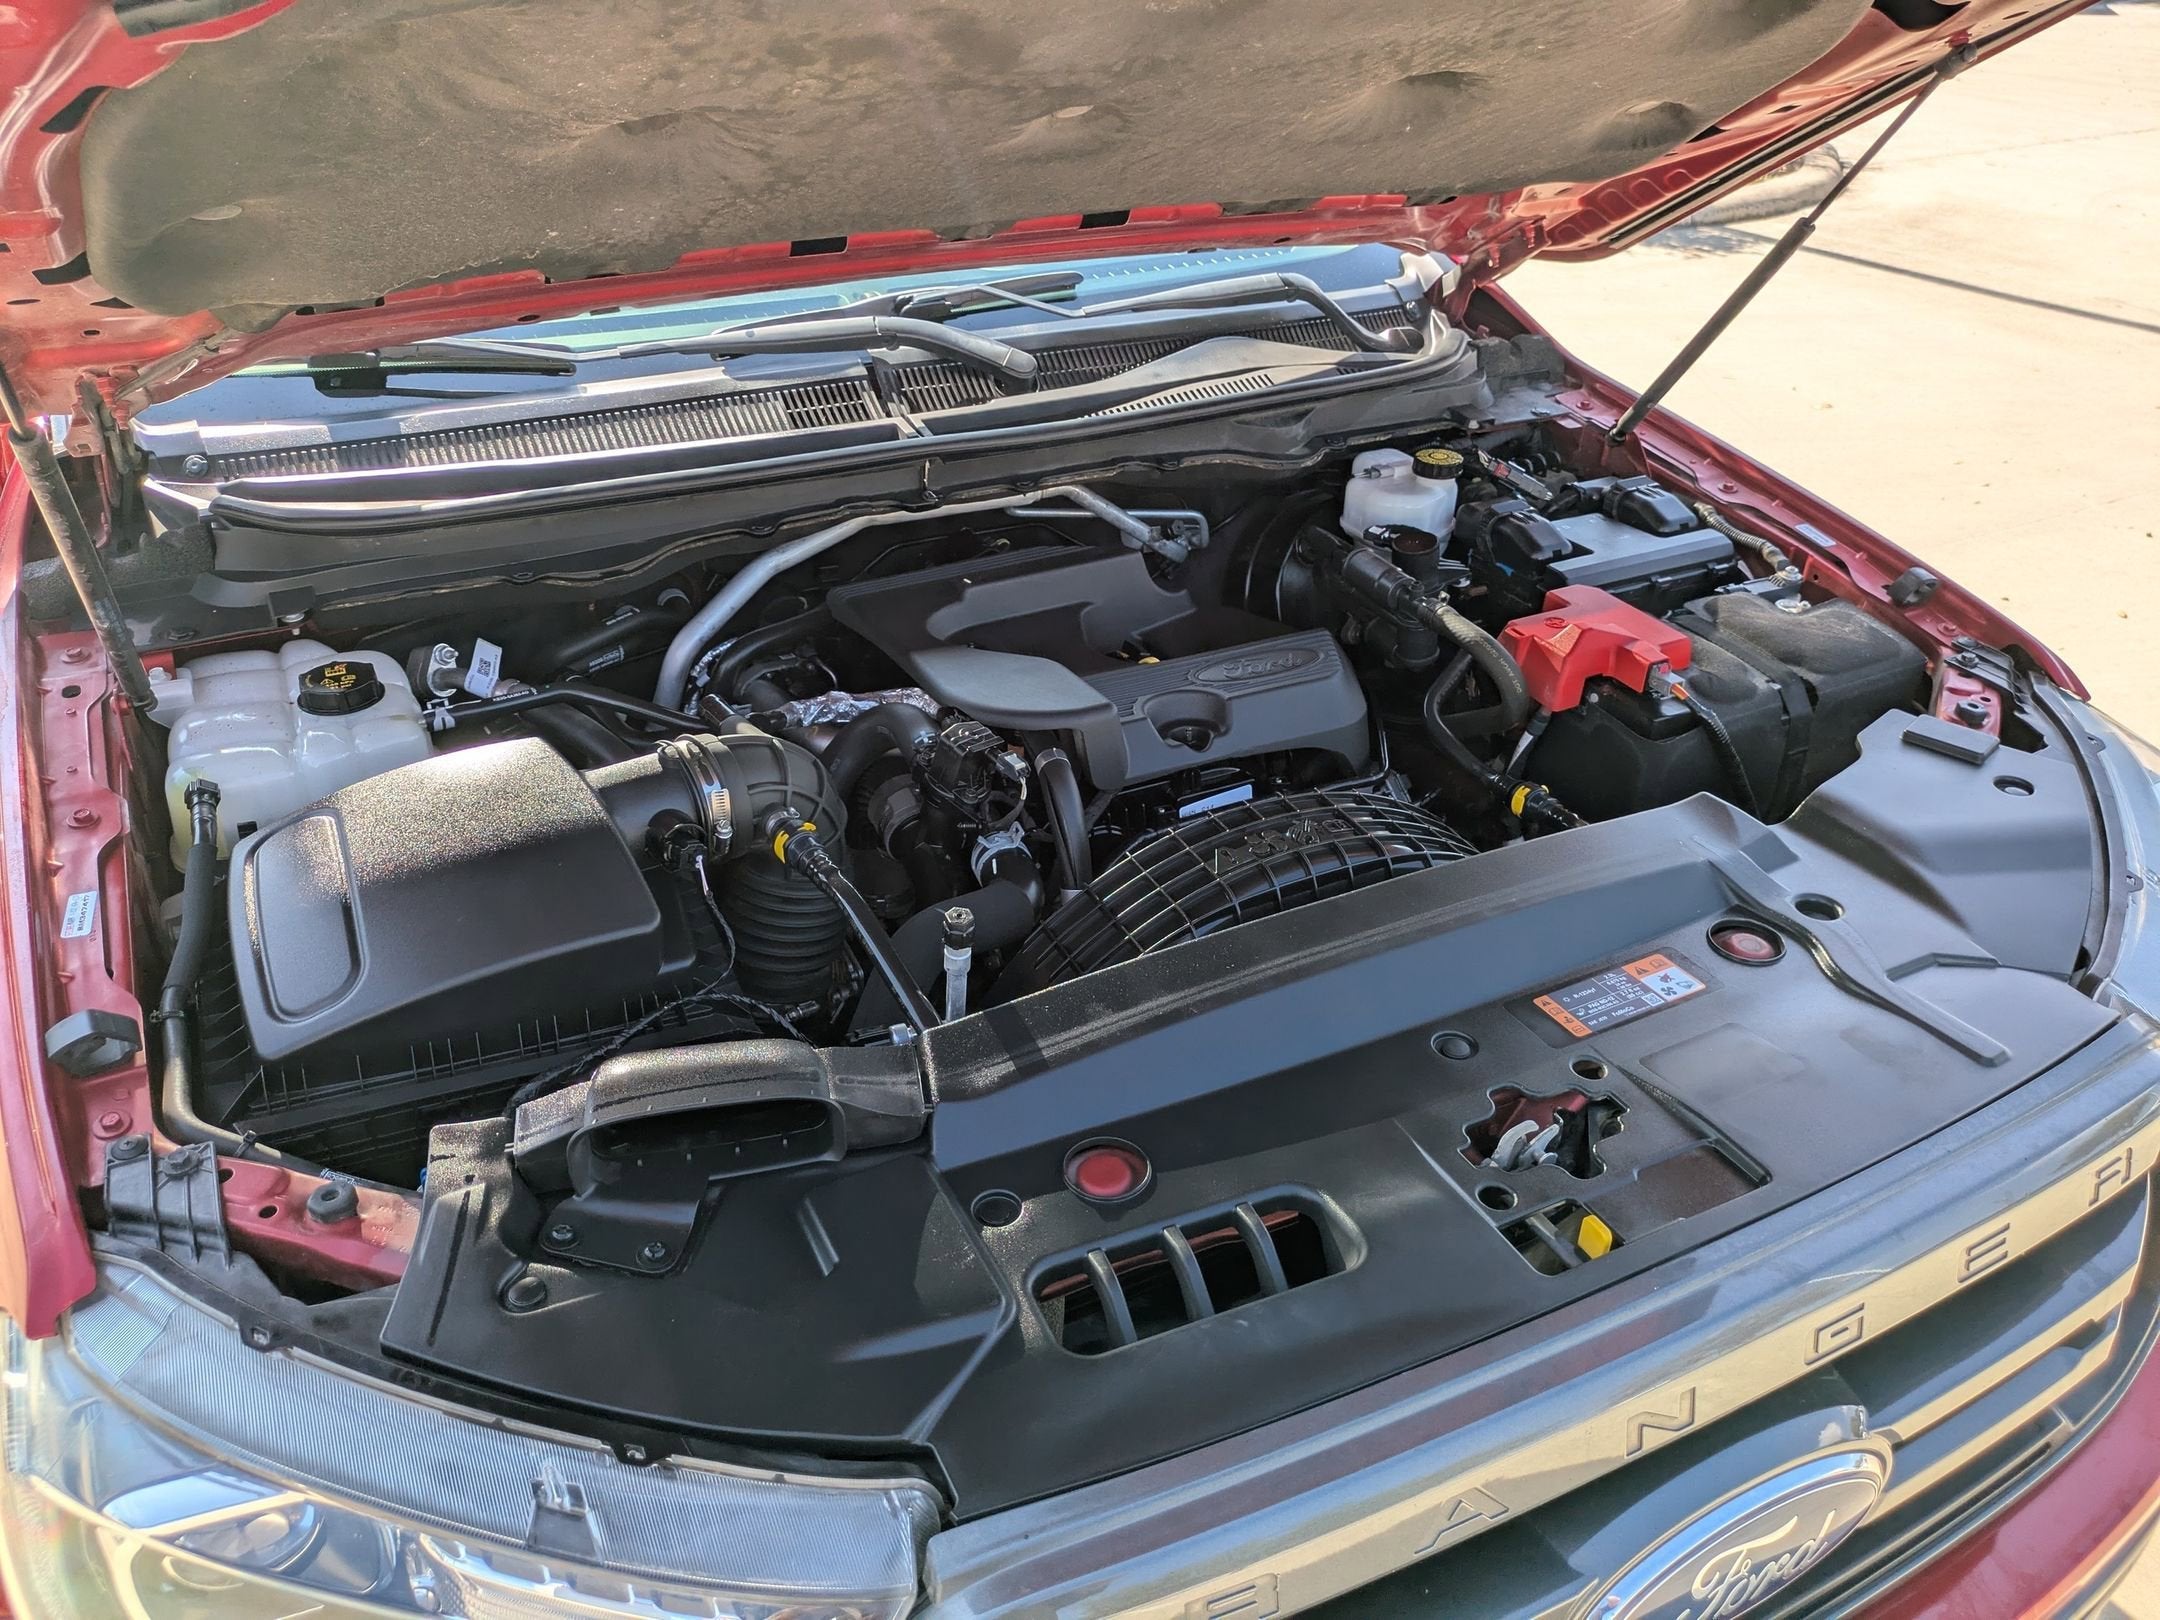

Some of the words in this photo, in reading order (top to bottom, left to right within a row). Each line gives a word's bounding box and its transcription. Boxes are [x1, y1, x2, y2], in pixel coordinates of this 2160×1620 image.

[1222, 652, 1303, 679] Ford
[1184, 1147, 2133, 1620] RANGER
[1676, 1508, 1837, 1620] Ford
